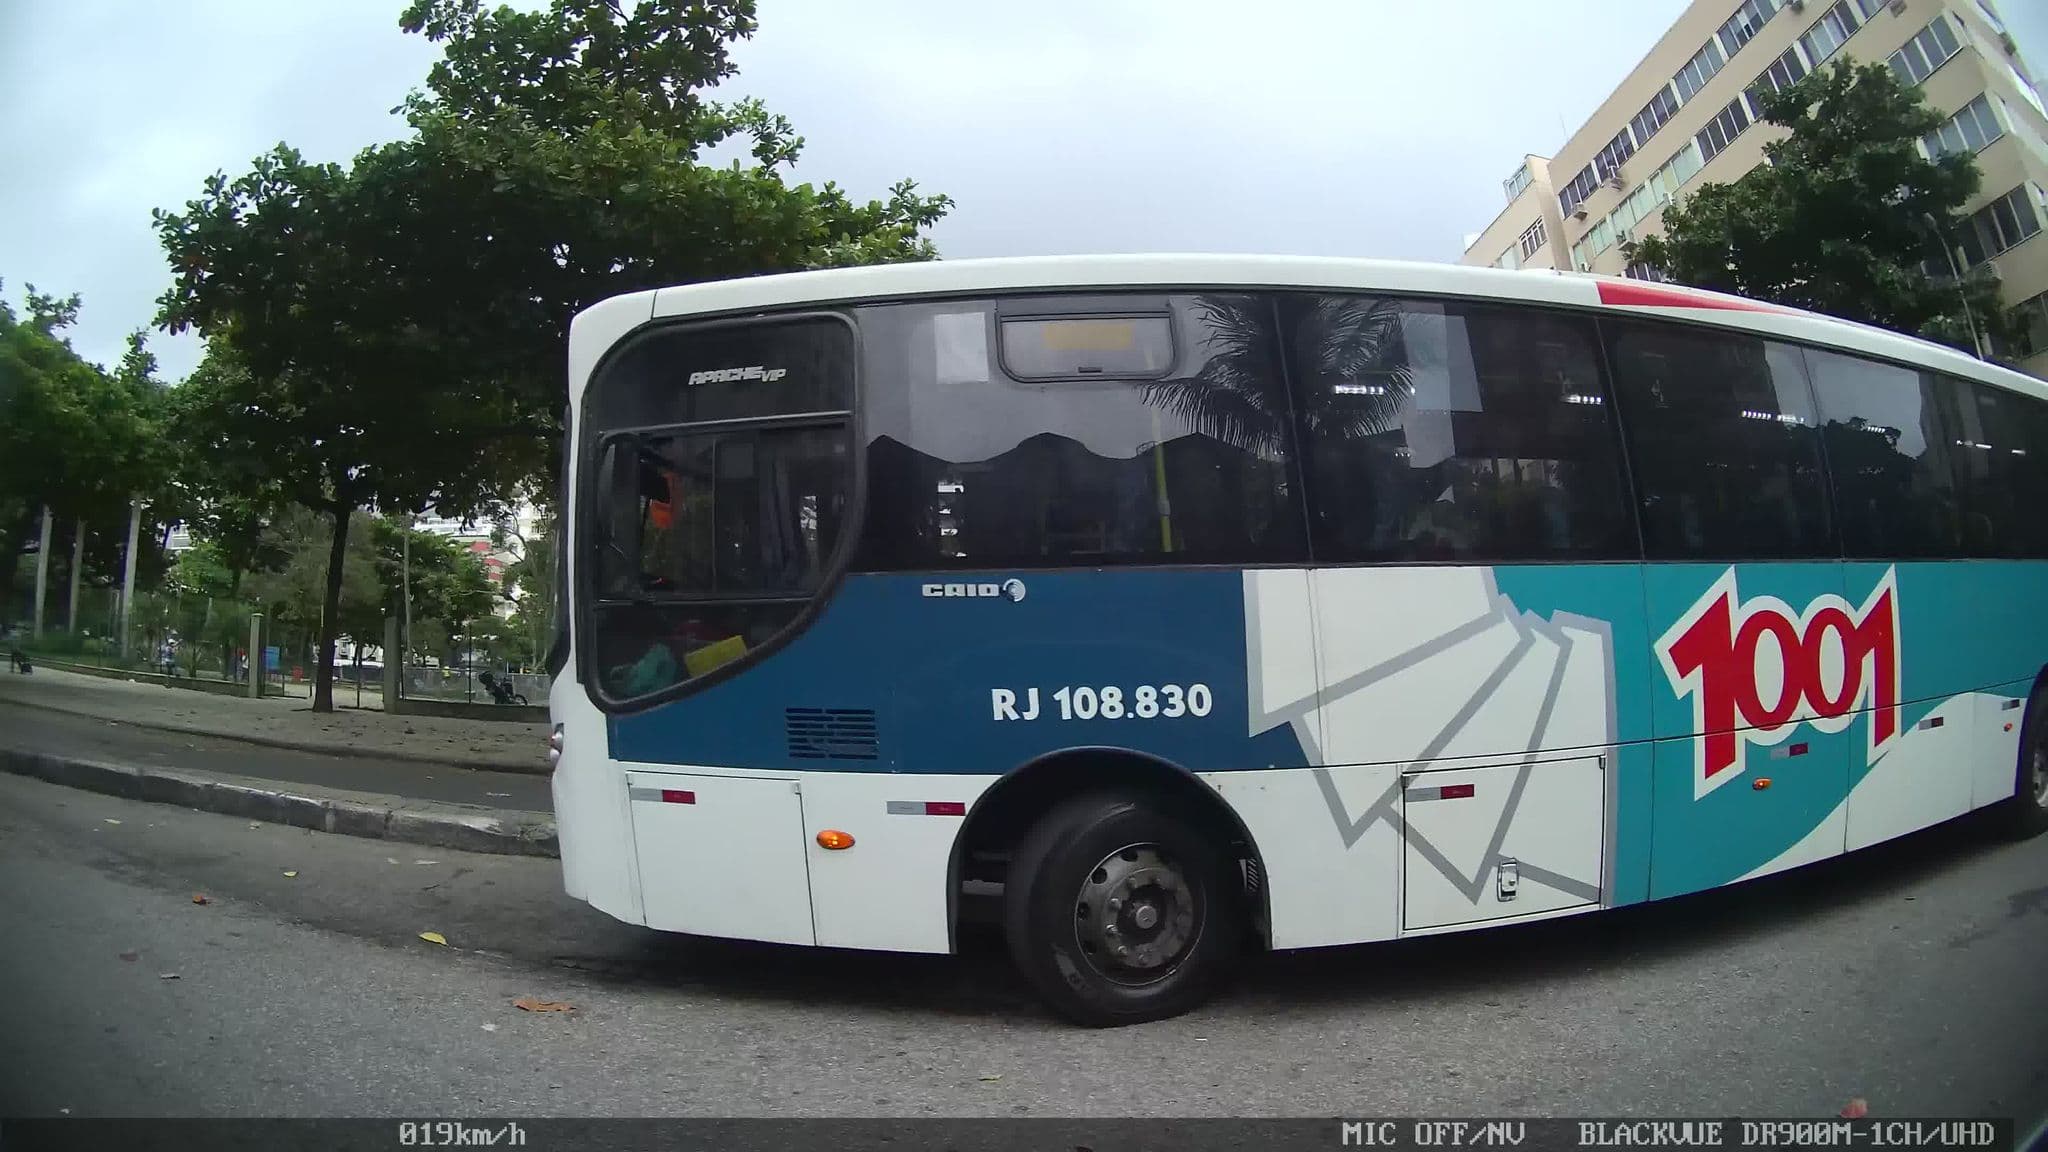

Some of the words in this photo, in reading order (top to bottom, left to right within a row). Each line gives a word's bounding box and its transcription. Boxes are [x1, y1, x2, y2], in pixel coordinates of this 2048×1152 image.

[688, 365, 764, 386] APACHE
[761, 368, 787, 383] VIP
[921, 583, 1000, 598] CAIO
[1660, 572, 1899, 792] 1001
[991, 686, 1041, 721] RJ
[1052, 683, 1213, 720] 108.830
